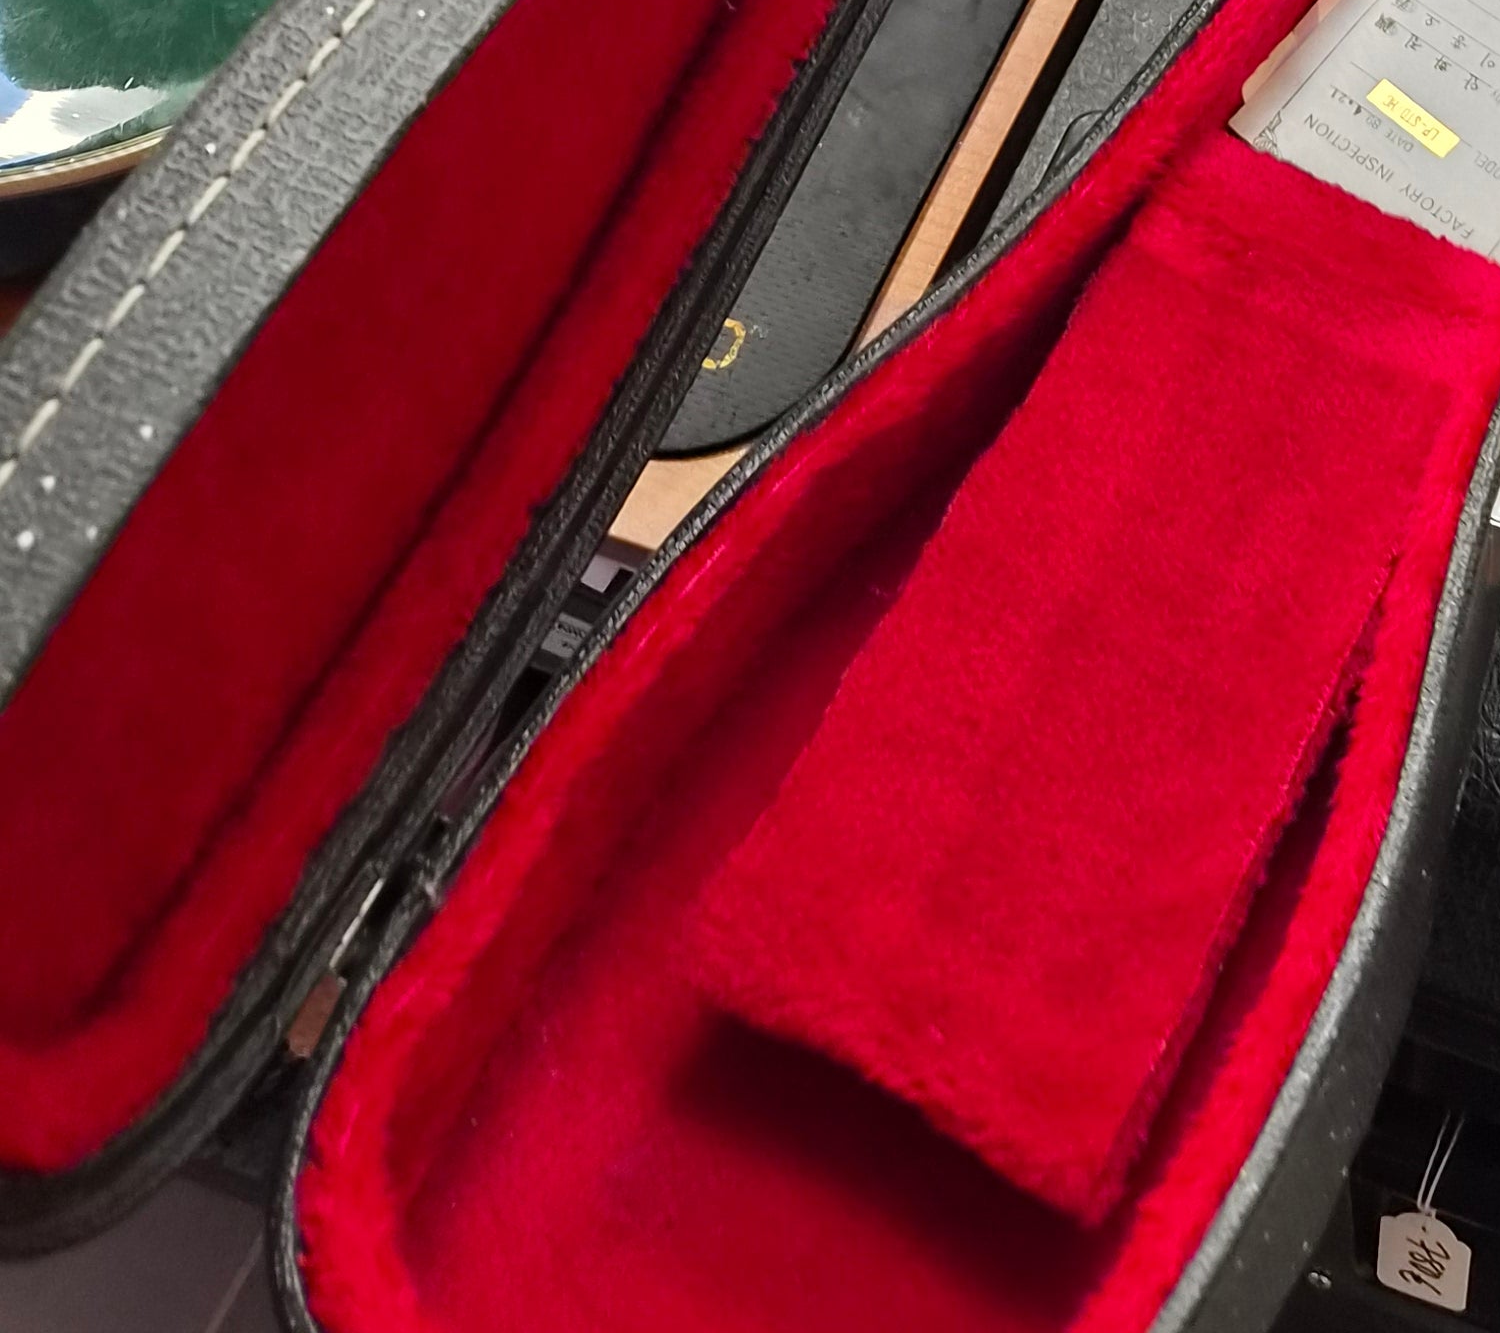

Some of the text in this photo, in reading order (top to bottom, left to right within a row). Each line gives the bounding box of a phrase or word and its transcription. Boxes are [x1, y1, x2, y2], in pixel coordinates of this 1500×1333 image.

[1304, 113, 1475, 240] FACTORY INSPECTION
[1384, 129, 1414, 153] DATE
